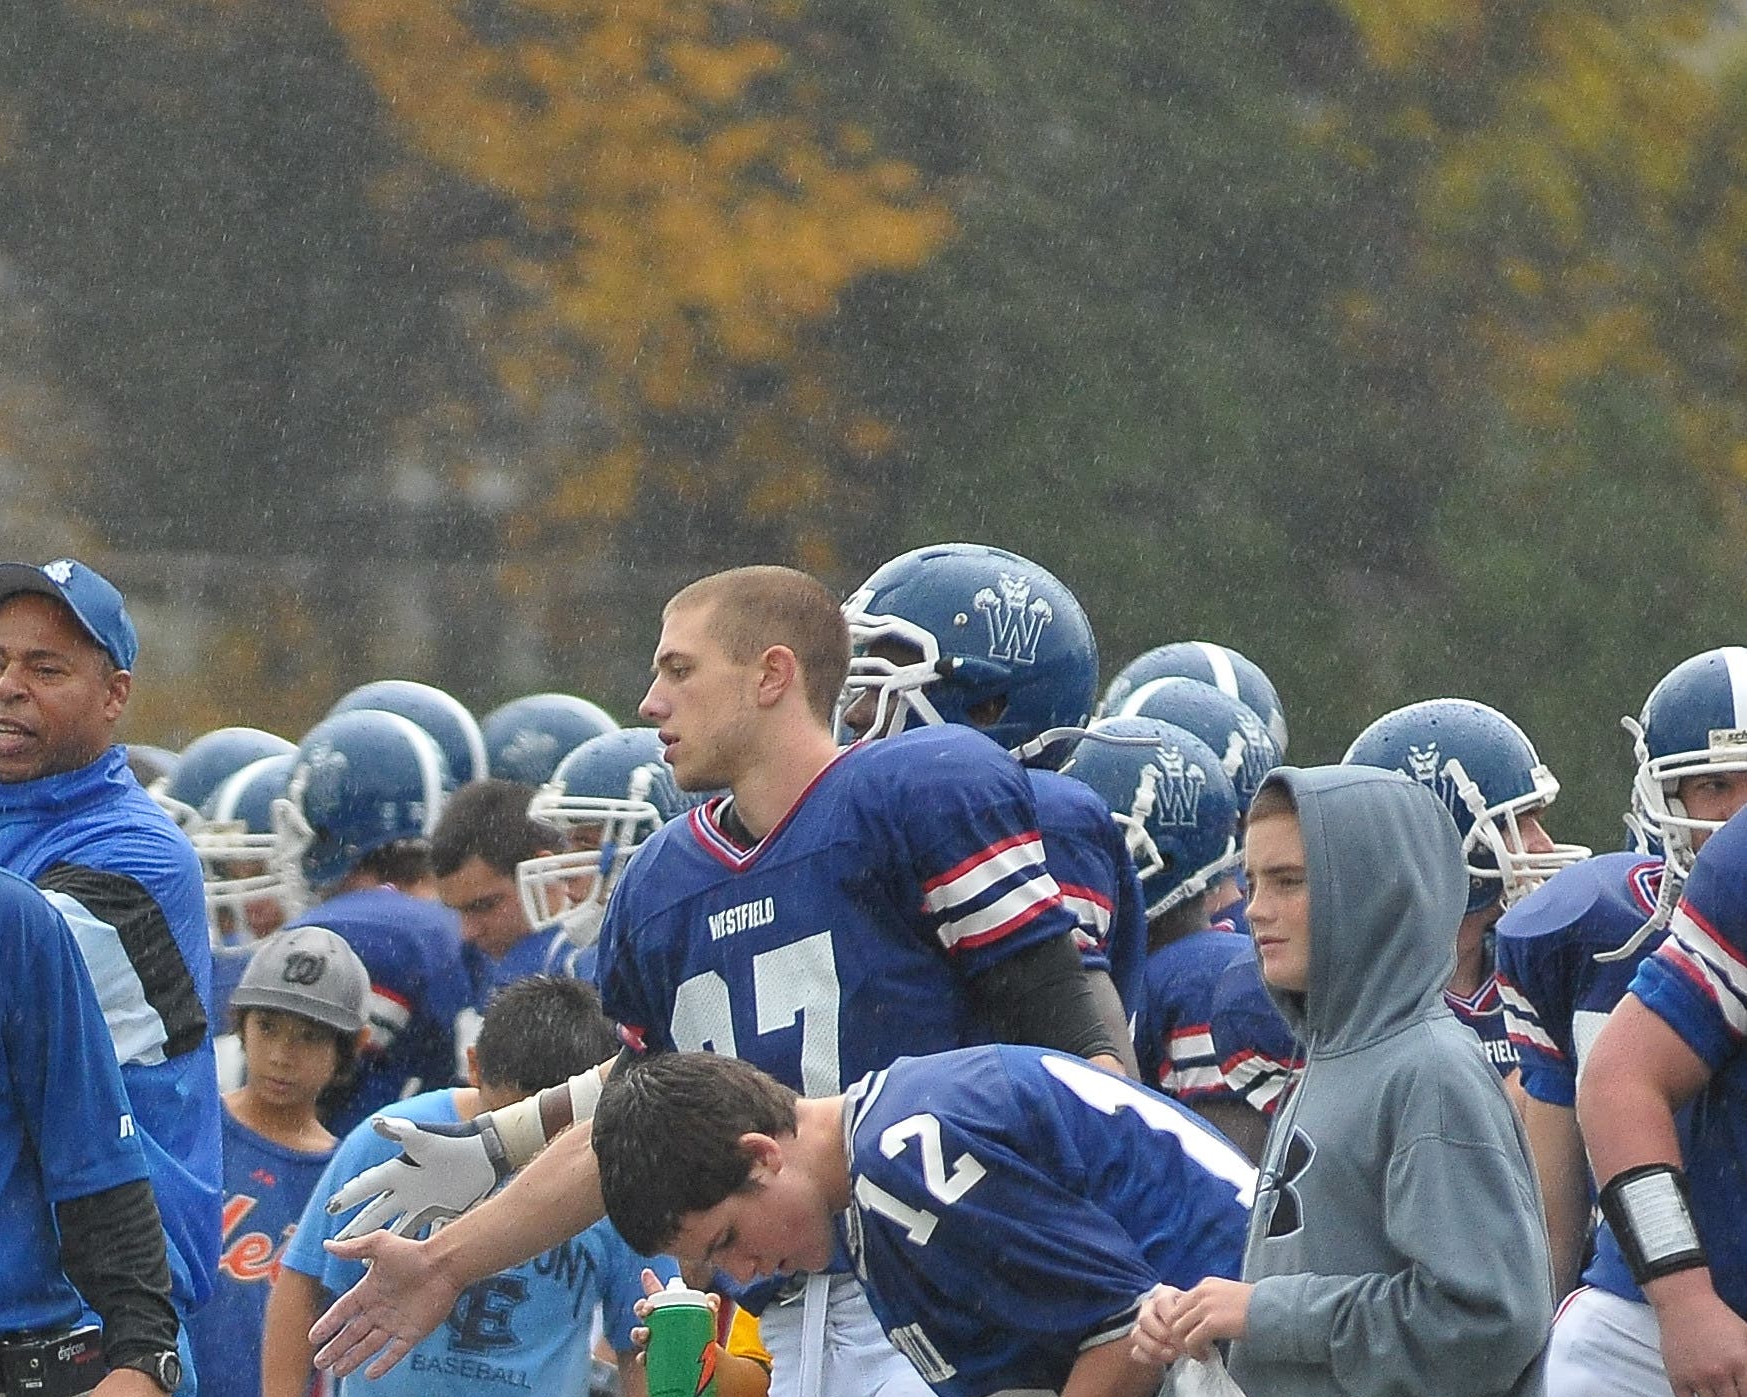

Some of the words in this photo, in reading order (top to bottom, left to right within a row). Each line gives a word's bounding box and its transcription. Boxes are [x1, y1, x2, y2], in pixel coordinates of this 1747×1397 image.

[708, 896, 775, 942] WESTFIELD
[855, 1113, 988, 1247] 12
[410, 1352, 532, 1390] BASEBALL
